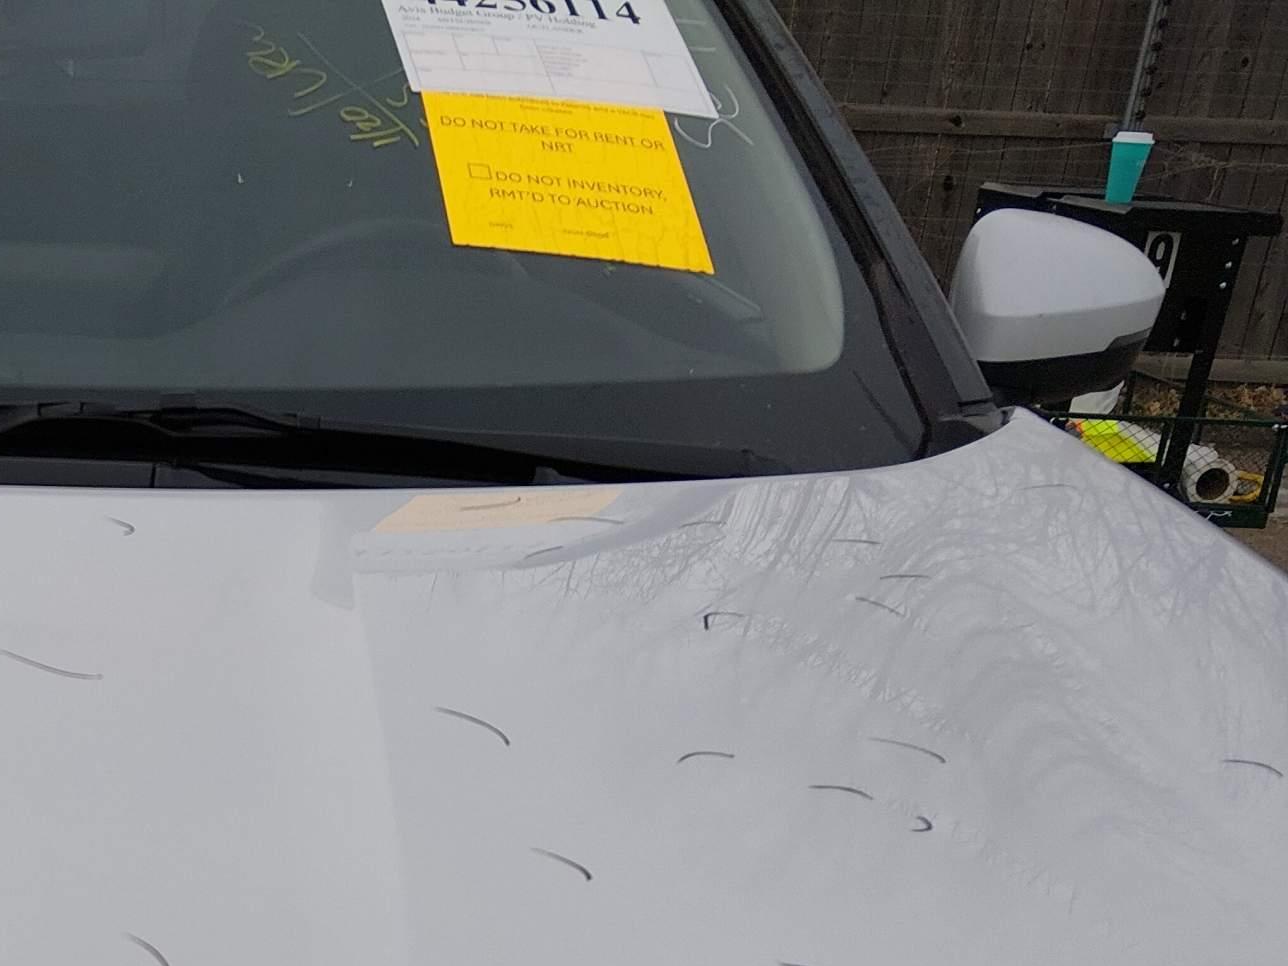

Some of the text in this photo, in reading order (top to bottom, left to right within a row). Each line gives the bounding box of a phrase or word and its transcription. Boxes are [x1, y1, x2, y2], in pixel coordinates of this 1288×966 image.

[398, 5, 426, 14] Avis
[430, 6, 474, 17] Budget
[476, 8, 515, 20] Group
[428, 0, 640, 24] 56114
[440, 115, 665, 150] DO NOT TAKE FOR RENT OR
[541, 140, 575, 153] NRT
[495, 170, 668, 202] DO NOT INVENTORY,
[550, 194, 571, 206] TO
[576, 197, 654, 215] AUCTION
